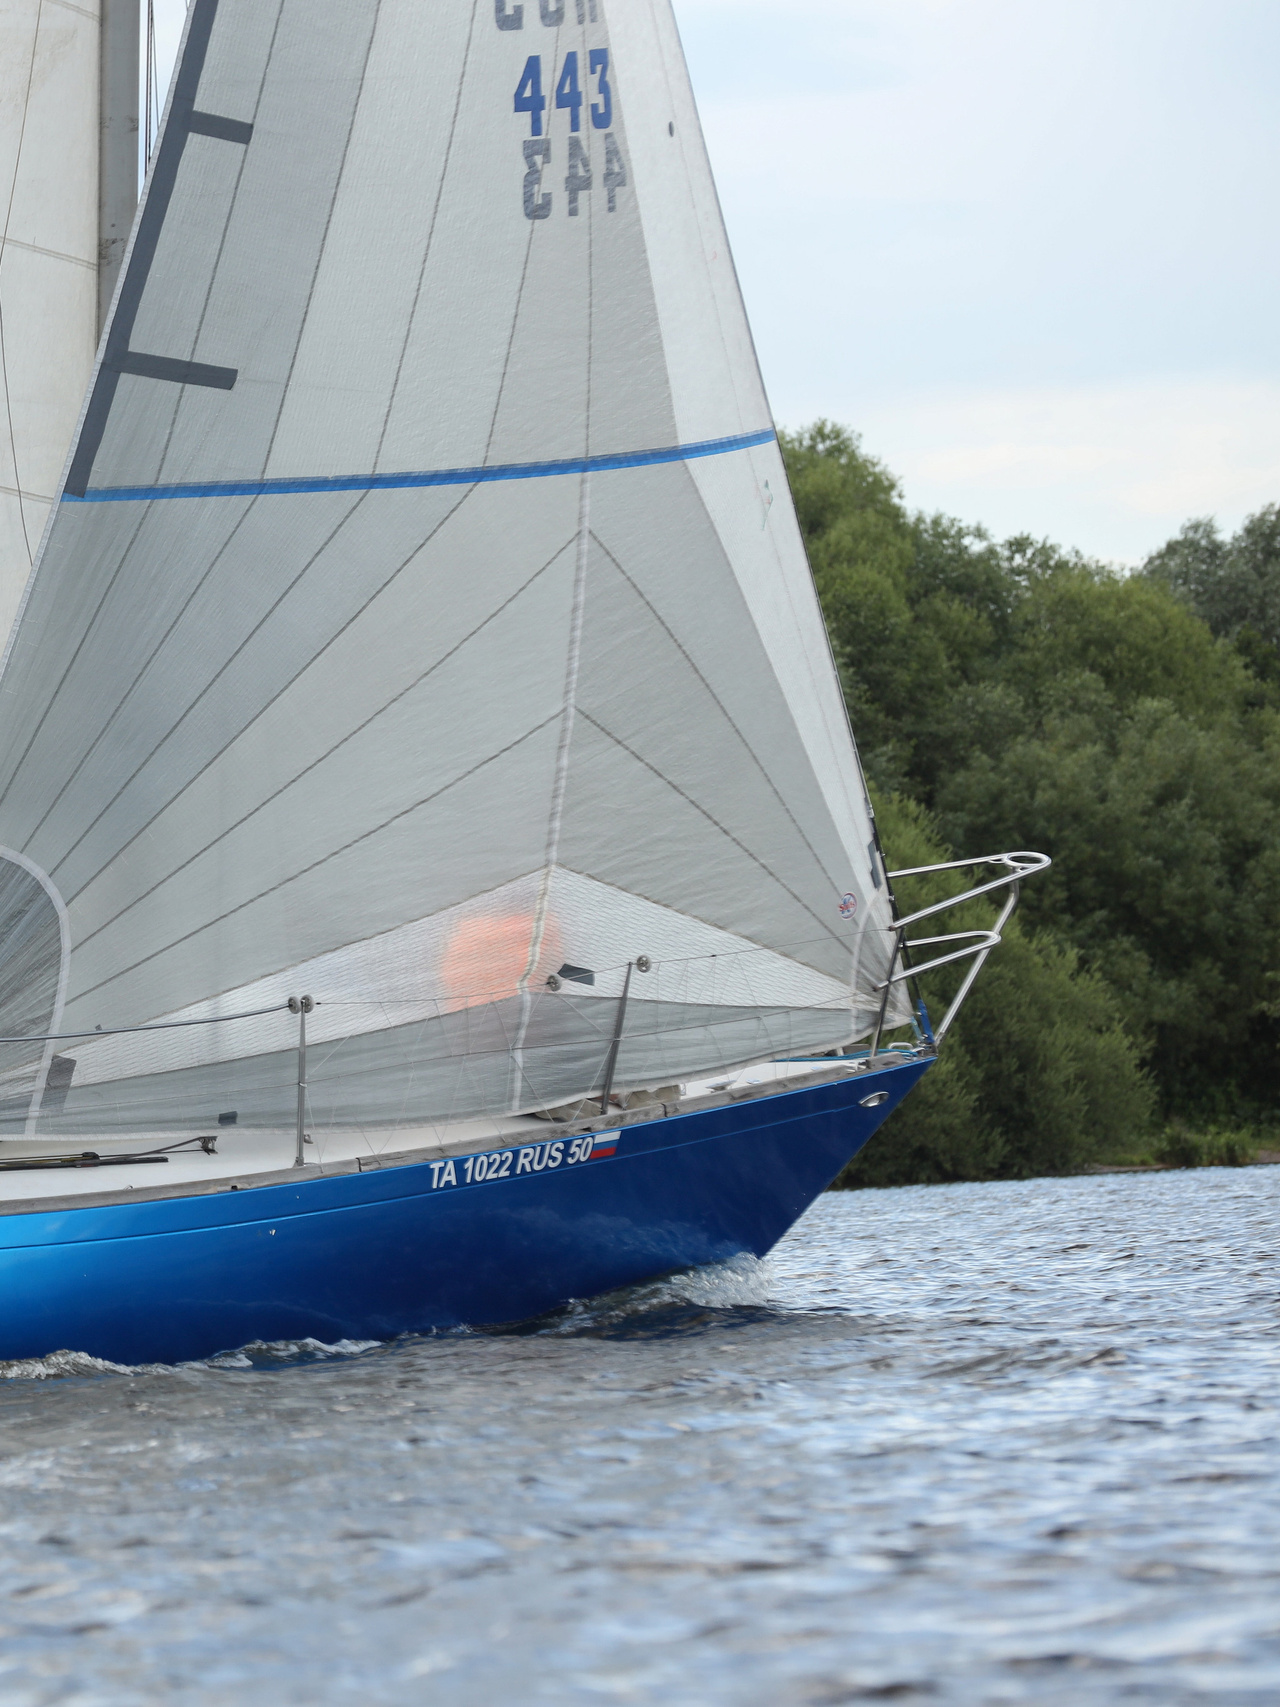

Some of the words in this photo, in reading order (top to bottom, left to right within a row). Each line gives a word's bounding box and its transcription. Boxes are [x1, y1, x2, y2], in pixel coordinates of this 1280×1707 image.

[514, 47, 613, 137] 443
[429, 1161, 457, 1189] TA
[464, 1151, 514, 1184] 1022
[516, 1142, 565, 1175] RUS
[567, 1137, 594, 1165] 50
